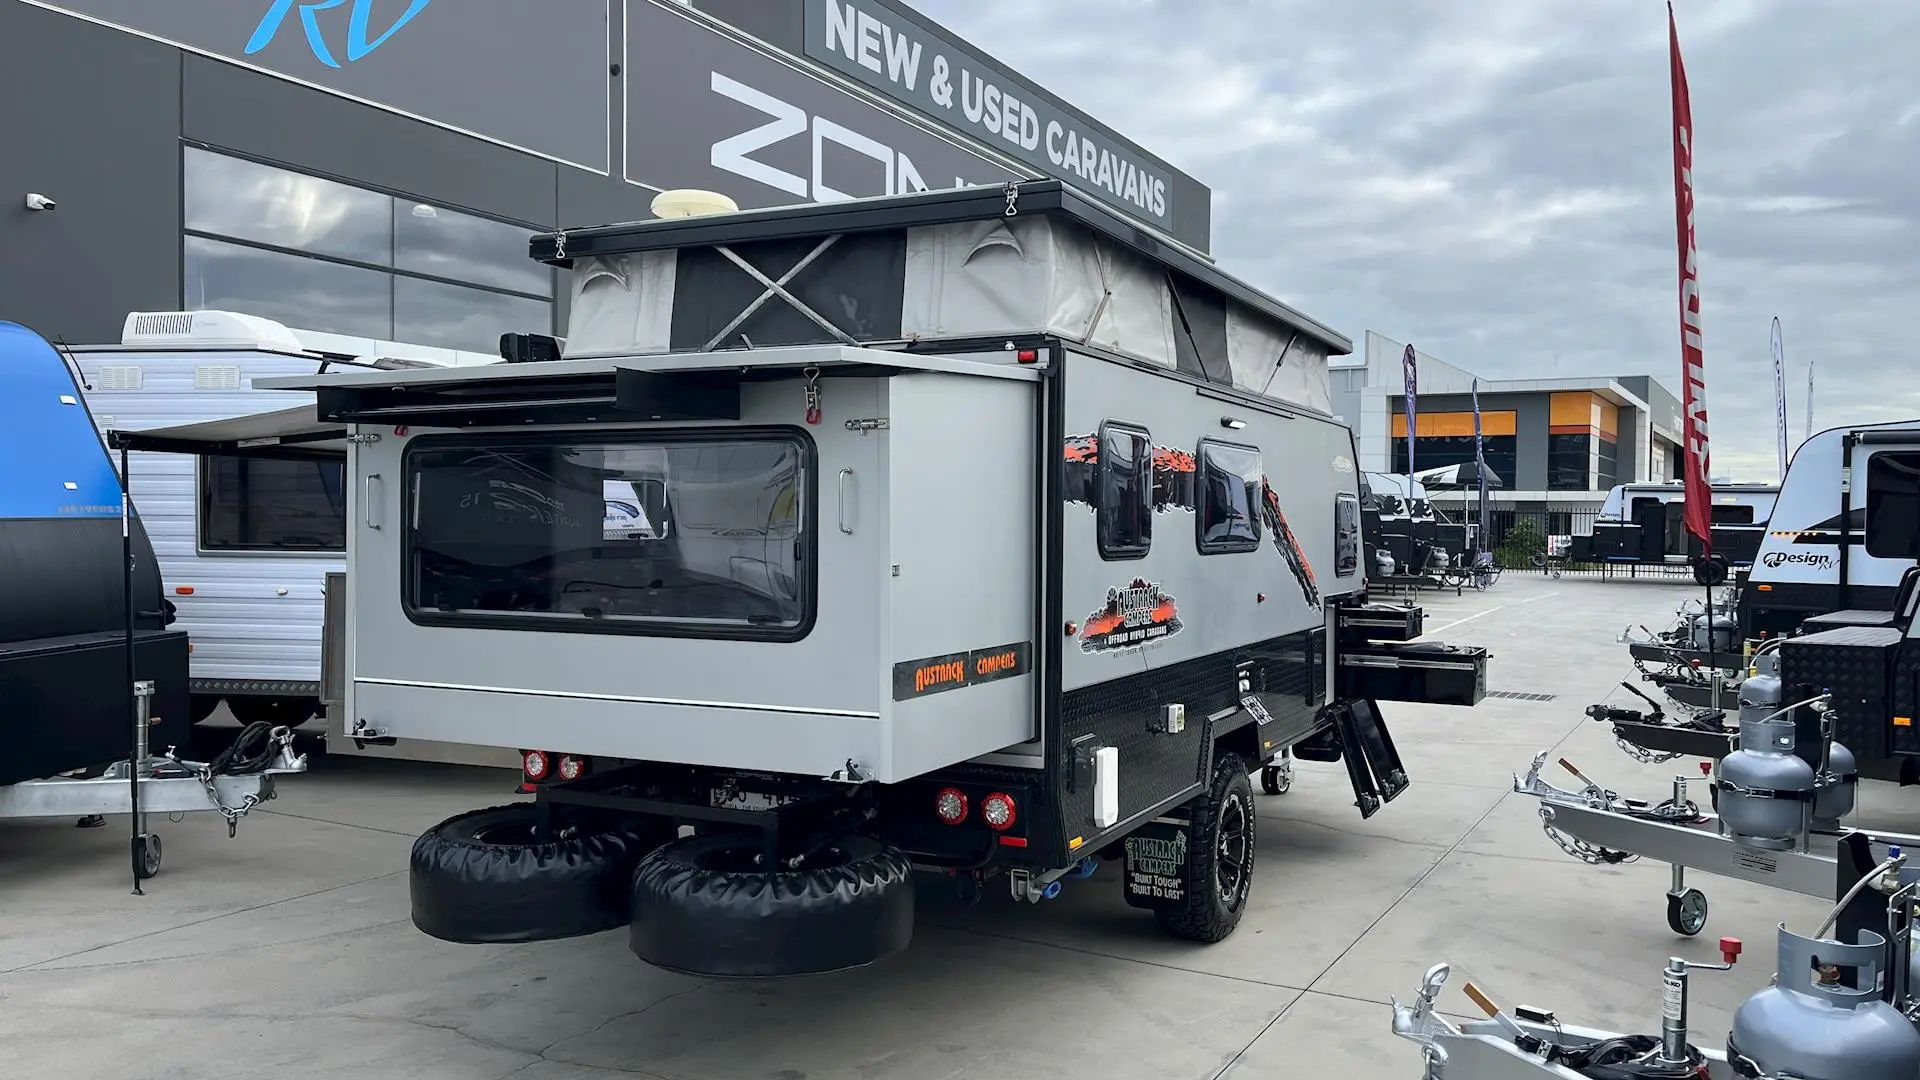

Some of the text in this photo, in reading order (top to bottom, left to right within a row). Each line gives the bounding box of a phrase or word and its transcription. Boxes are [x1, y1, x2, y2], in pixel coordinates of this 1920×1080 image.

[825, 0, 1166, 218] NEW & USED CARAVANS
[1776, 552, 1829, 566] Design
[1117, 584, 1159, 617] AUSTRACK
[1108, 633, 1128, 644] OFFROAD
[1147, 626, 1167, 637] CARAVANS
[915, 652, 1016, 692] AUSTRACK CAMPERS
